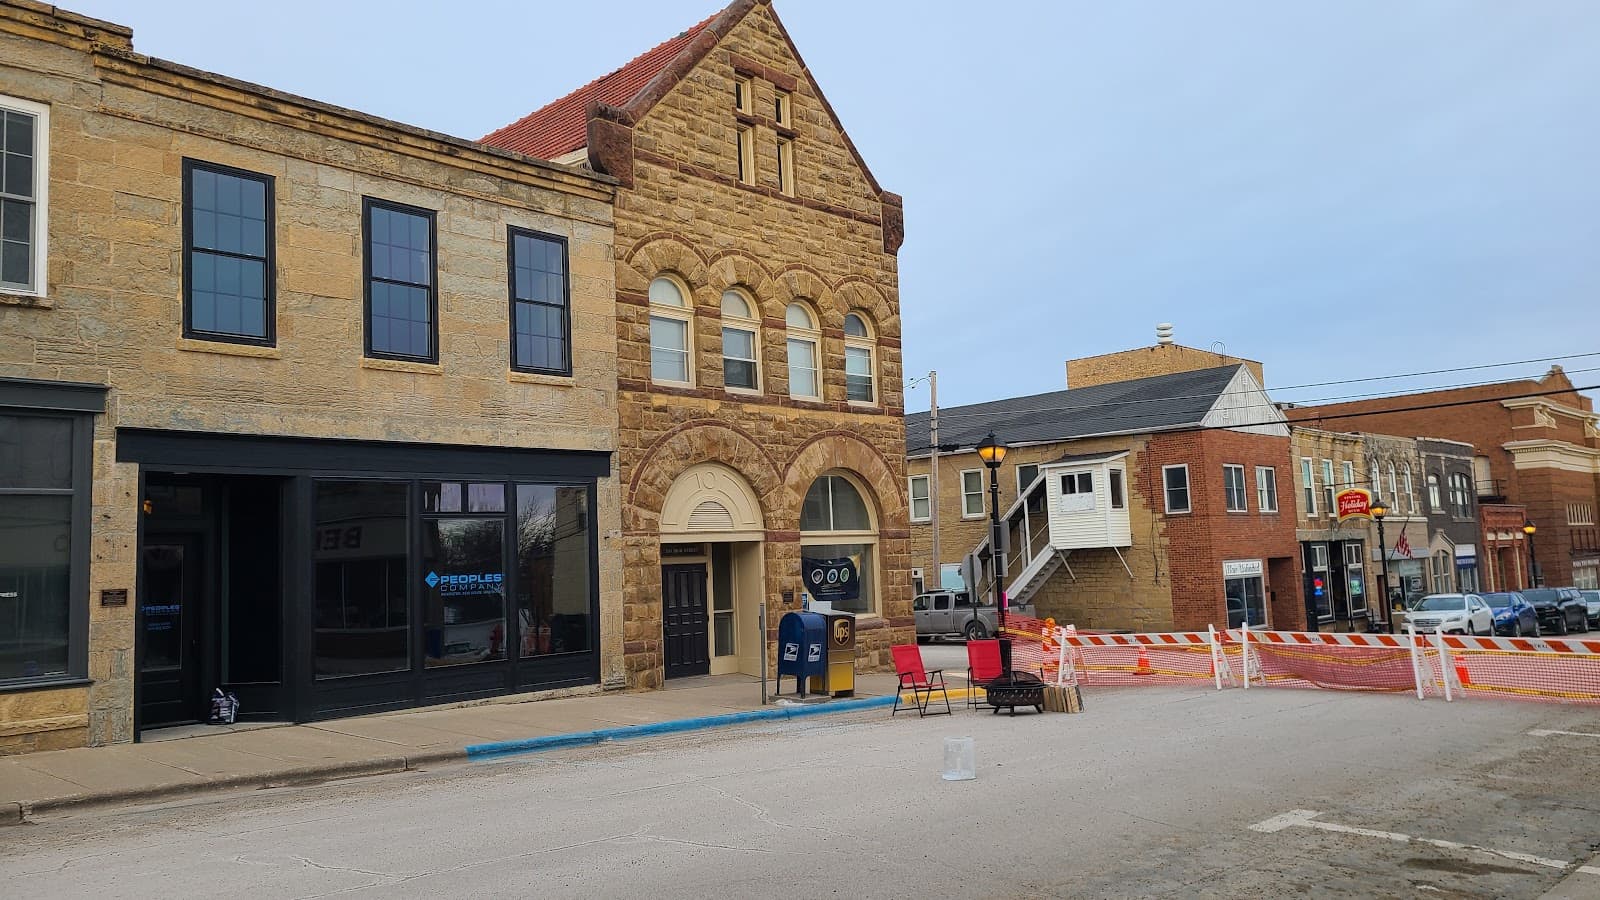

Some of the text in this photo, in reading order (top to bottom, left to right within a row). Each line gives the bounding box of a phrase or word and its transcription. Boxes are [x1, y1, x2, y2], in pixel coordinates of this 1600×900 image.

[1340, 499, 1368, 512] Holiday
[440, 573, 503, 584] PEOPLES
[440, 583, 503, 592] COMPANY
[835, 624, 849, 642] ups
